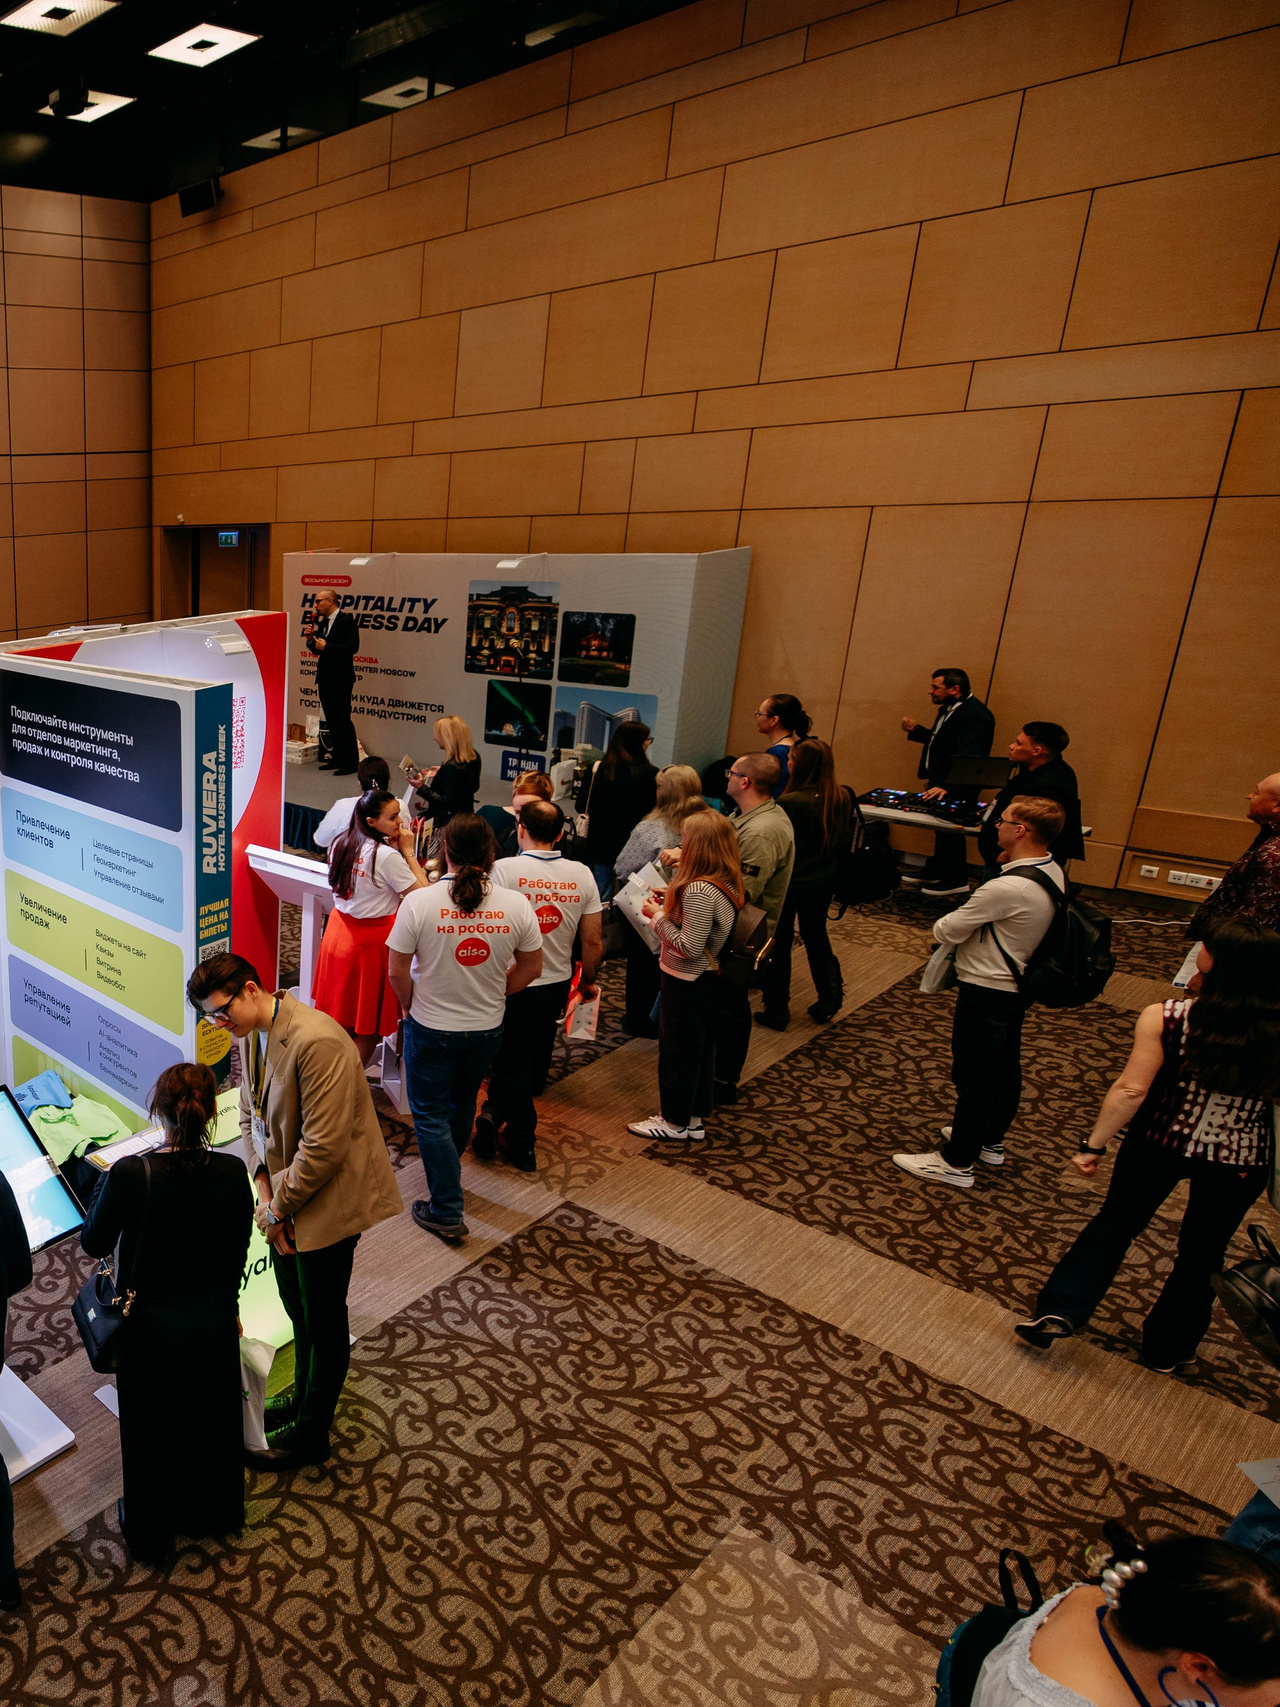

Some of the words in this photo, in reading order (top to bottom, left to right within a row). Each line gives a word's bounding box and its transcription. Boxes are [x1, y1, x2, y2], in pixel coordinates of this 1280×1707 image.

[300, 593, 438, 614] HSPITALITY
[402, 616, 449, 634] DAY
[300, 660, 318, 668] WORL
[354, 666, 378, 674] ENTER
[380, 668, 416, 678] MOSCOW
[353, 656, 379, 664] ОСКВА
[300, 688, 318, 696] ЧЕМ
[360, 695, 386, 706] КУДА
[387, 698, 444, 714] ДВИЖЕТСЯ
[11, 705, 68, 730] Подключайте
[69, 721, 134, 746] инструменты
[367, 709, 427, 724] ИНДУСТРИЯ
[12, 723, 26, 734] для
[27, 726, 62, 744] отделов
[64, 736, 120, 762] маркетинга,
[218, 724, 226, 764] WEEK
[12, 738, 43, 754] продаж
[44, 747, 50, 756] и
[51, 750, 94, 768] контроля
[94, 762, 140, 782] качества
[508, 758, 539, 770] ТРНДЫ
[218, 766, 226, 830] BUSINESS
[202, 750, 218, 874] RUVIERA
[16, 810, 71, 840] Привлечение
[16, 826, 54, 848] клиентов
[92, 839, 120, 856] Целевые
[120, 850, 154, 869] страницы
[218, 833, 226, 872] HOTEL
[94, 854, 137, 878] Геомаркетинг
[94, 868, 131, 891] Управление
[132, 884, 165, 905] отзывами
[518, 878, 577, 890] Работаю
[20, 892, 68, 924] Увеличение
[200, 898, 229, 916] ЛУЧШАЯ
[534, 893, 580, 904] робота
[20, 908, 50, 930] продаж
[200, 914, 218, 928] ЦЕНА
[219, 910, 229, 922] НА
[440, 908, 504, 920] Работаю
[200, 922, 228, 940] БИЛЕТЫ
[436, 924, 455, 934] на
[458, 924, 510, 936] робота
[96, 928, 122, 947] Виджеты
[123, 943, 131, 951] на
[132, 945, 147, 960] сайт
[96, 943, 114, 958] Квизы
[458, 948, 488, 958] aiso
[96, 956, 122, 976] Витрина
[96, 970, 126, 992] Видеобот
[23, 978, 71, 1014] Управление
[24, 993, 71, 1028] репутацией
[98, 1015, 122, 1034] Опросы
[98, 1029, 138, 1058] AI-аналитика
[99, 1042, 121, 1061] Анализ
[99, 1051, 138, 1079] конкурентов
[100, 1063, 139, 1092] Бенчмаркинг
